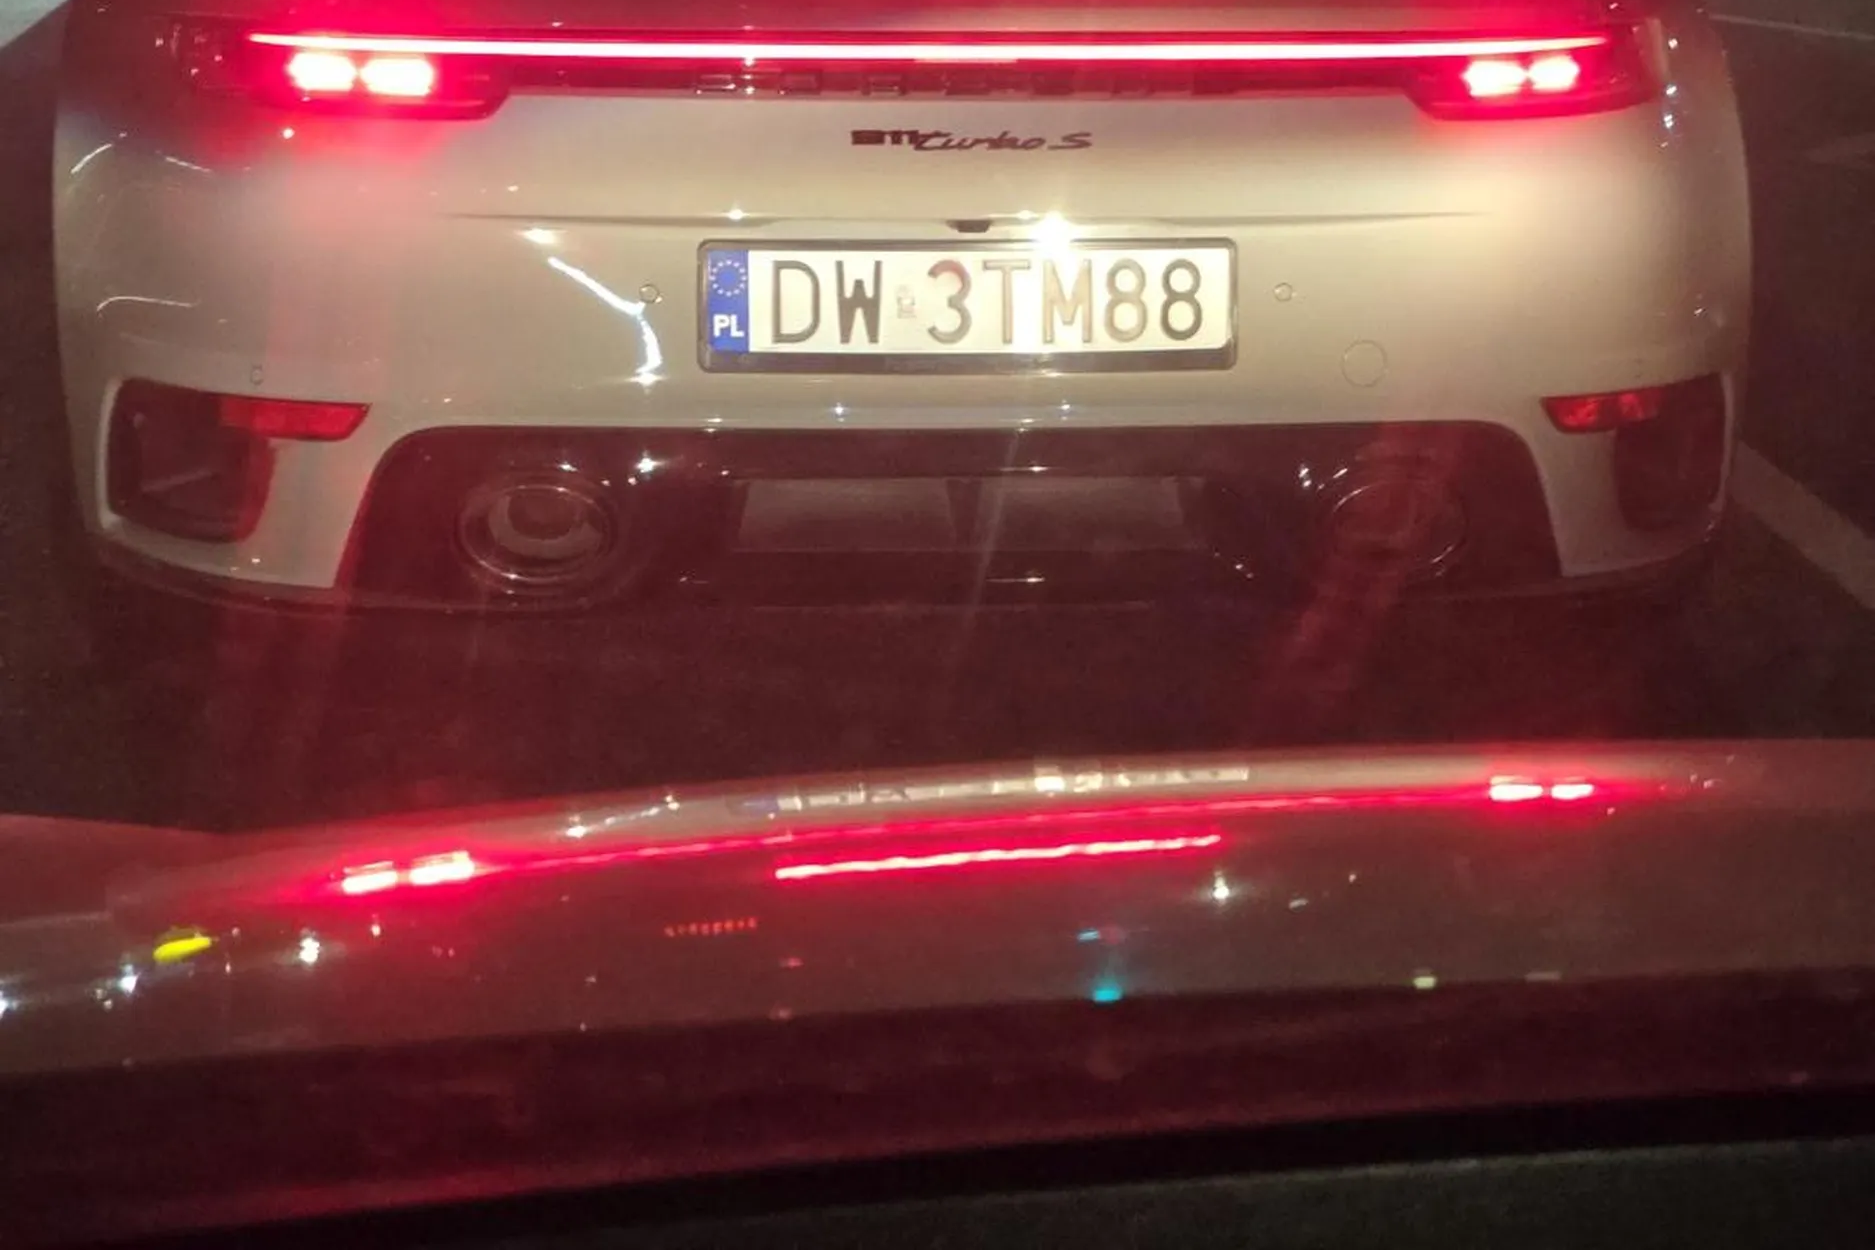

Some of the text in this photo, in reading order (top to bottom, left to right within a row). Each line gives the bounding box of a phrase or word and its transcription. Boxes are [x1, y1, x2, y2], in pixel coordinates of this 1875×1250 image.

[914, 131, 1046, 151] turbo
[1047, 132, 1092, 151] S
[770, 257, 1203, 344] DW 3TM88
[713, 313, 745, 340] PL
